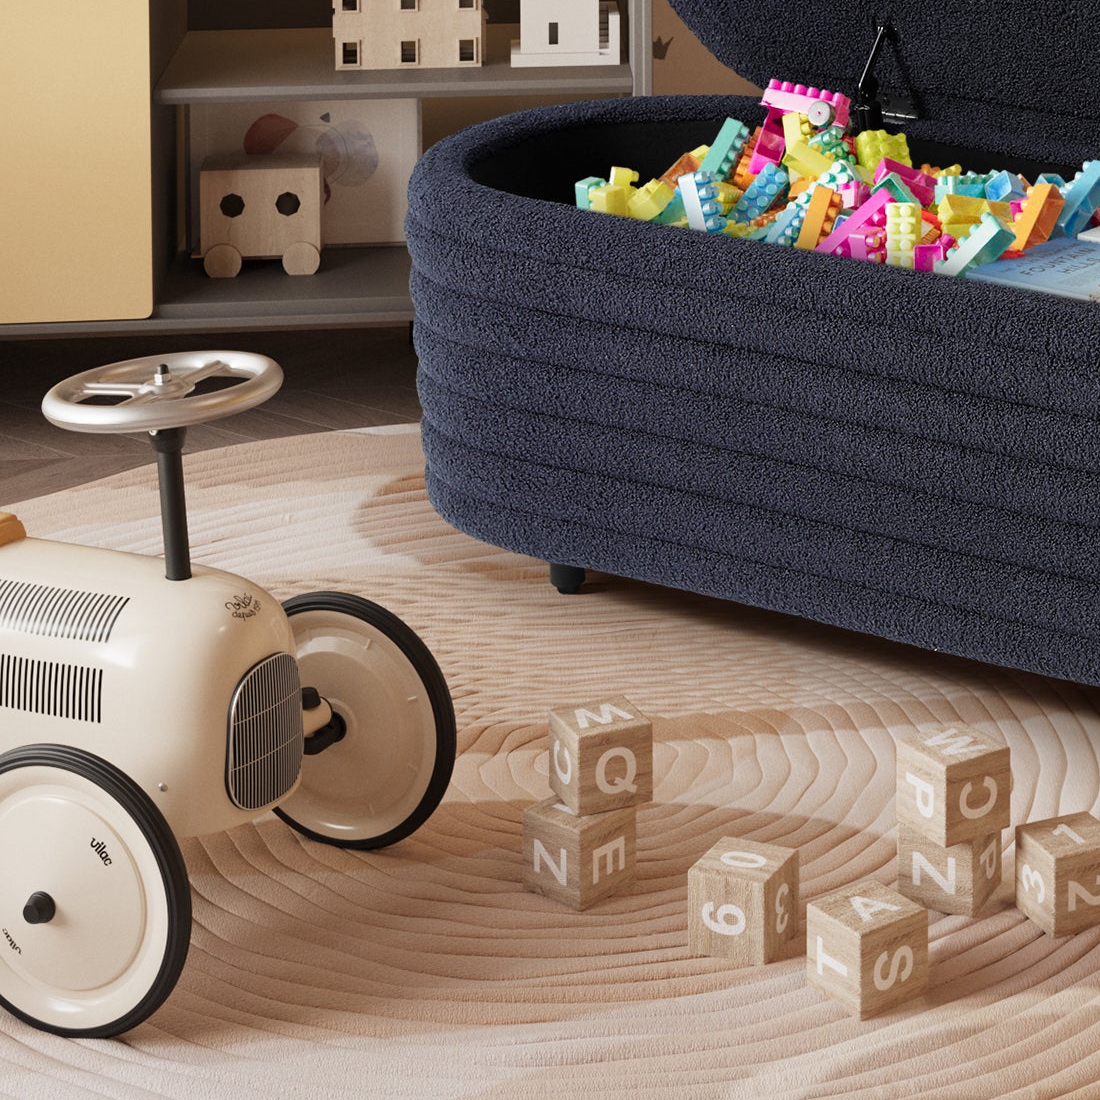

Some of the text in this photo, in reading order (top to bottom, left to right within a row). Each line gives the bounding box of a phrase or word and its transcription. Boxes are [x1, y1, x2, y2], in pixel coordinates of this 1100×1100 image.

[1020, 248, 1097, 276] FOUNTAIN
[595, 746, 638, 794] Q
[906, 771, 935, 819] P
[959, 776, 998, 820] C
[90, 837, 112, 867] vilac
[1021, 863, 1046, 904] 3
[850, 895, 902, 923] A
[816, 935, 848, 977] T
[873, 945, 914, 991] S
